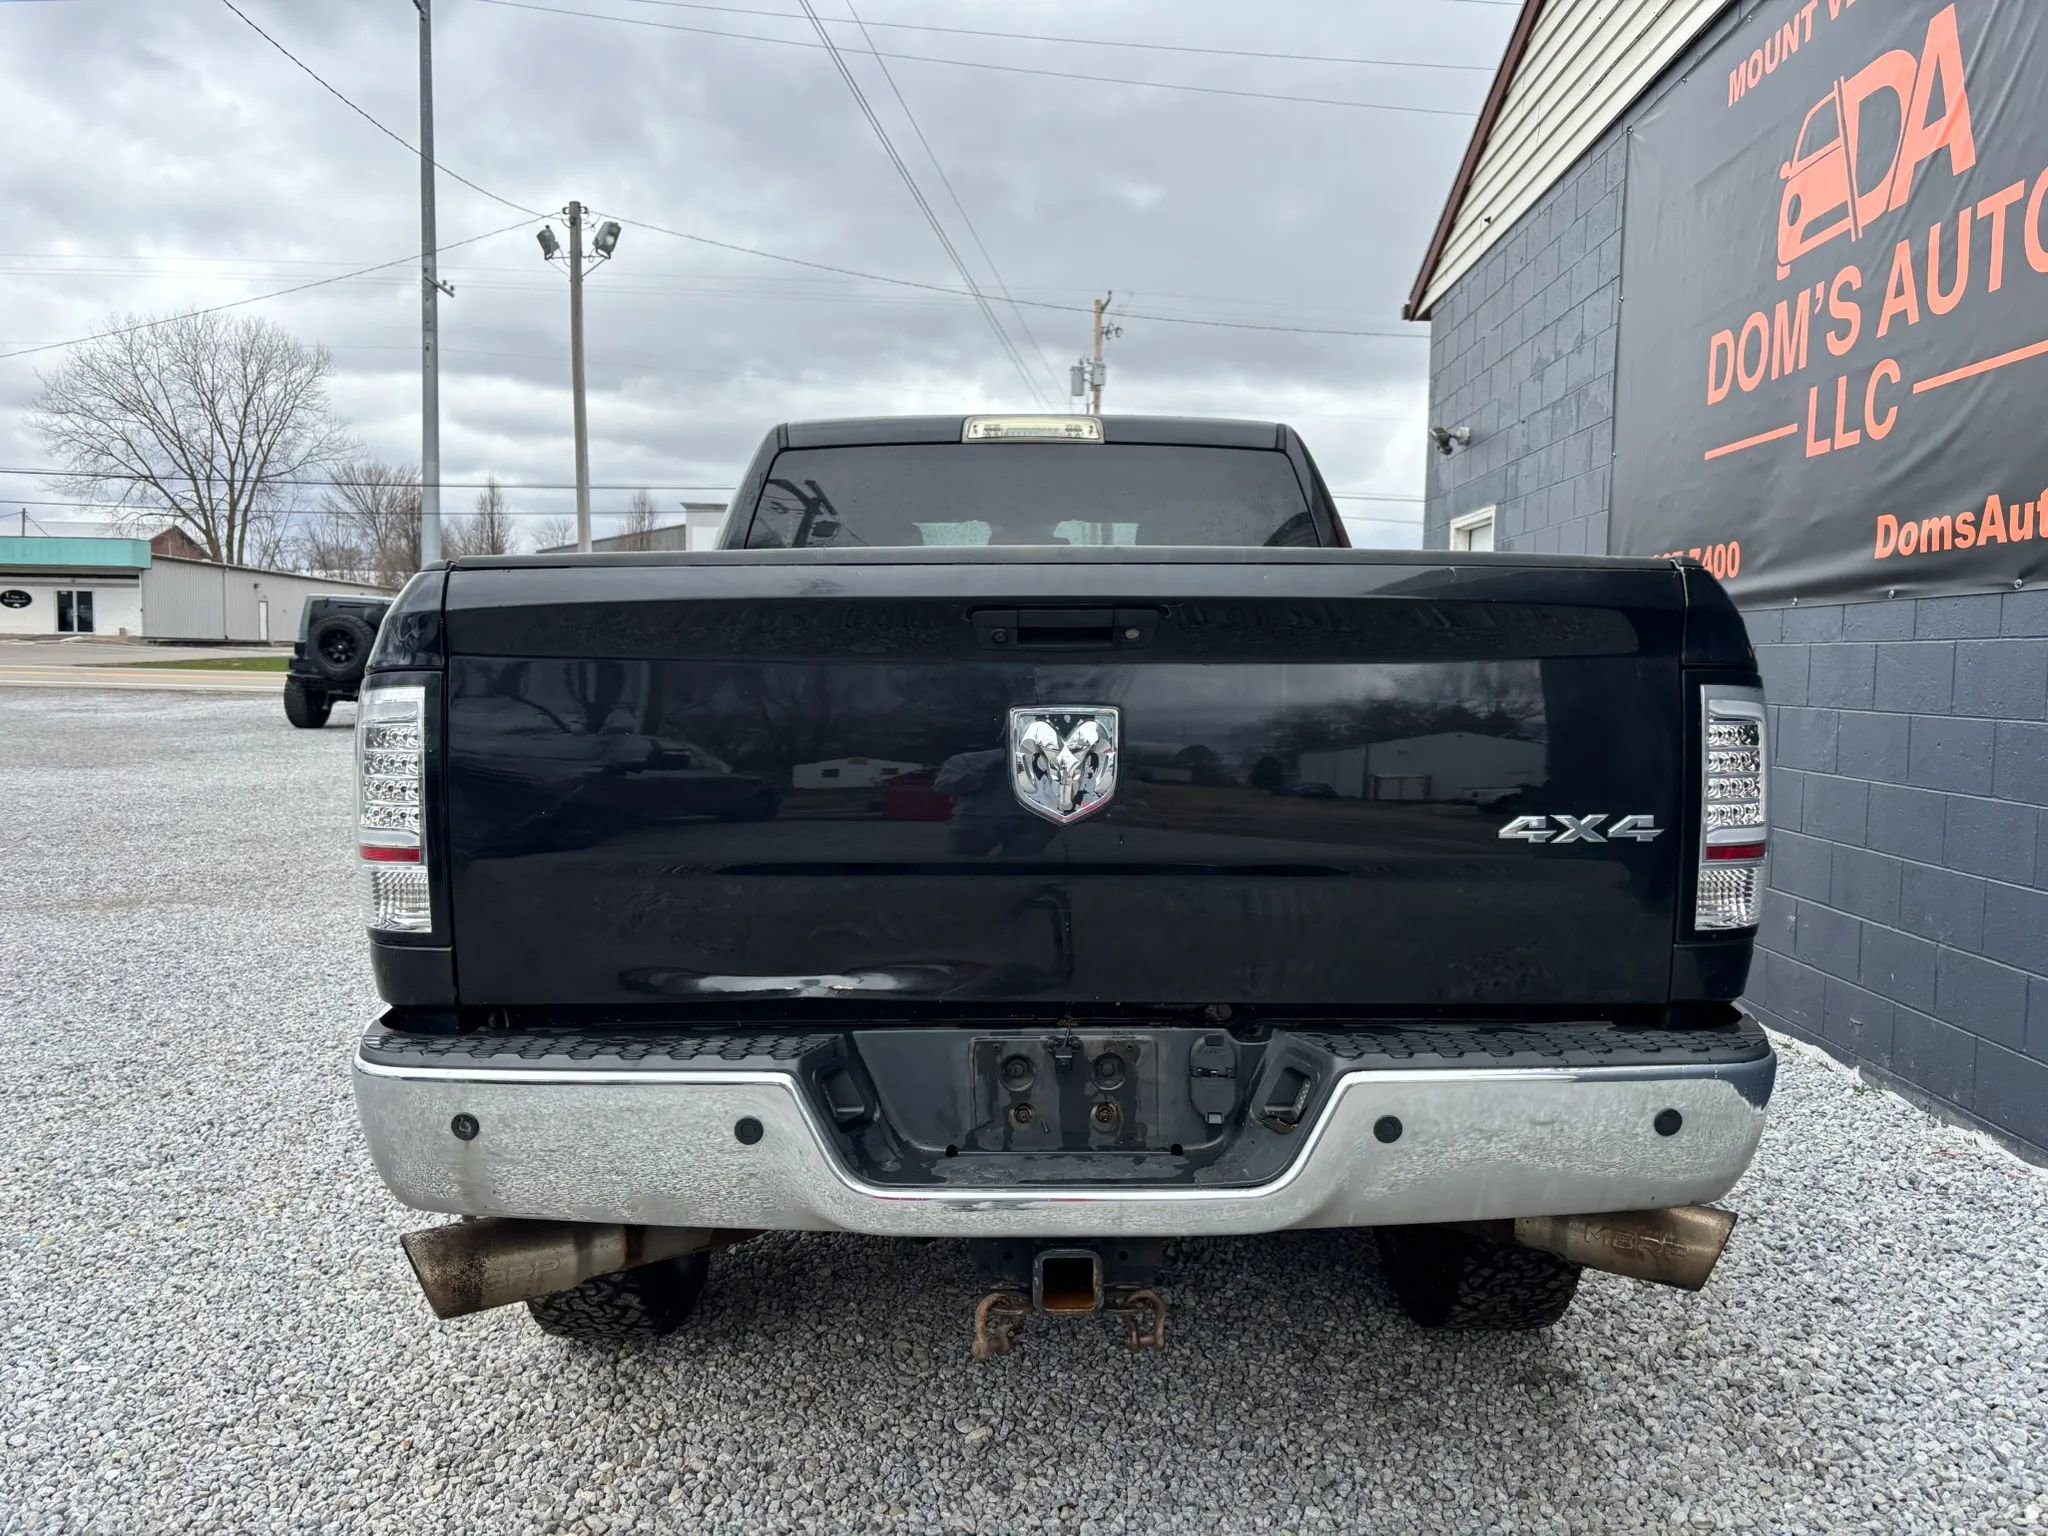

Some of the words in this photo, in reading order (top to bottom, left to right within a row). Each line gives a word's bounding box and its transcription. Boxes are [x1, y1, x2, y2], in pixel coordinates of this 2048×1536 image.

[1728, 0, 1818, 108] MOUNT
[1707, 265, 1862, 406] DOM'S
[1805, 358, 1901, 459] LLC
